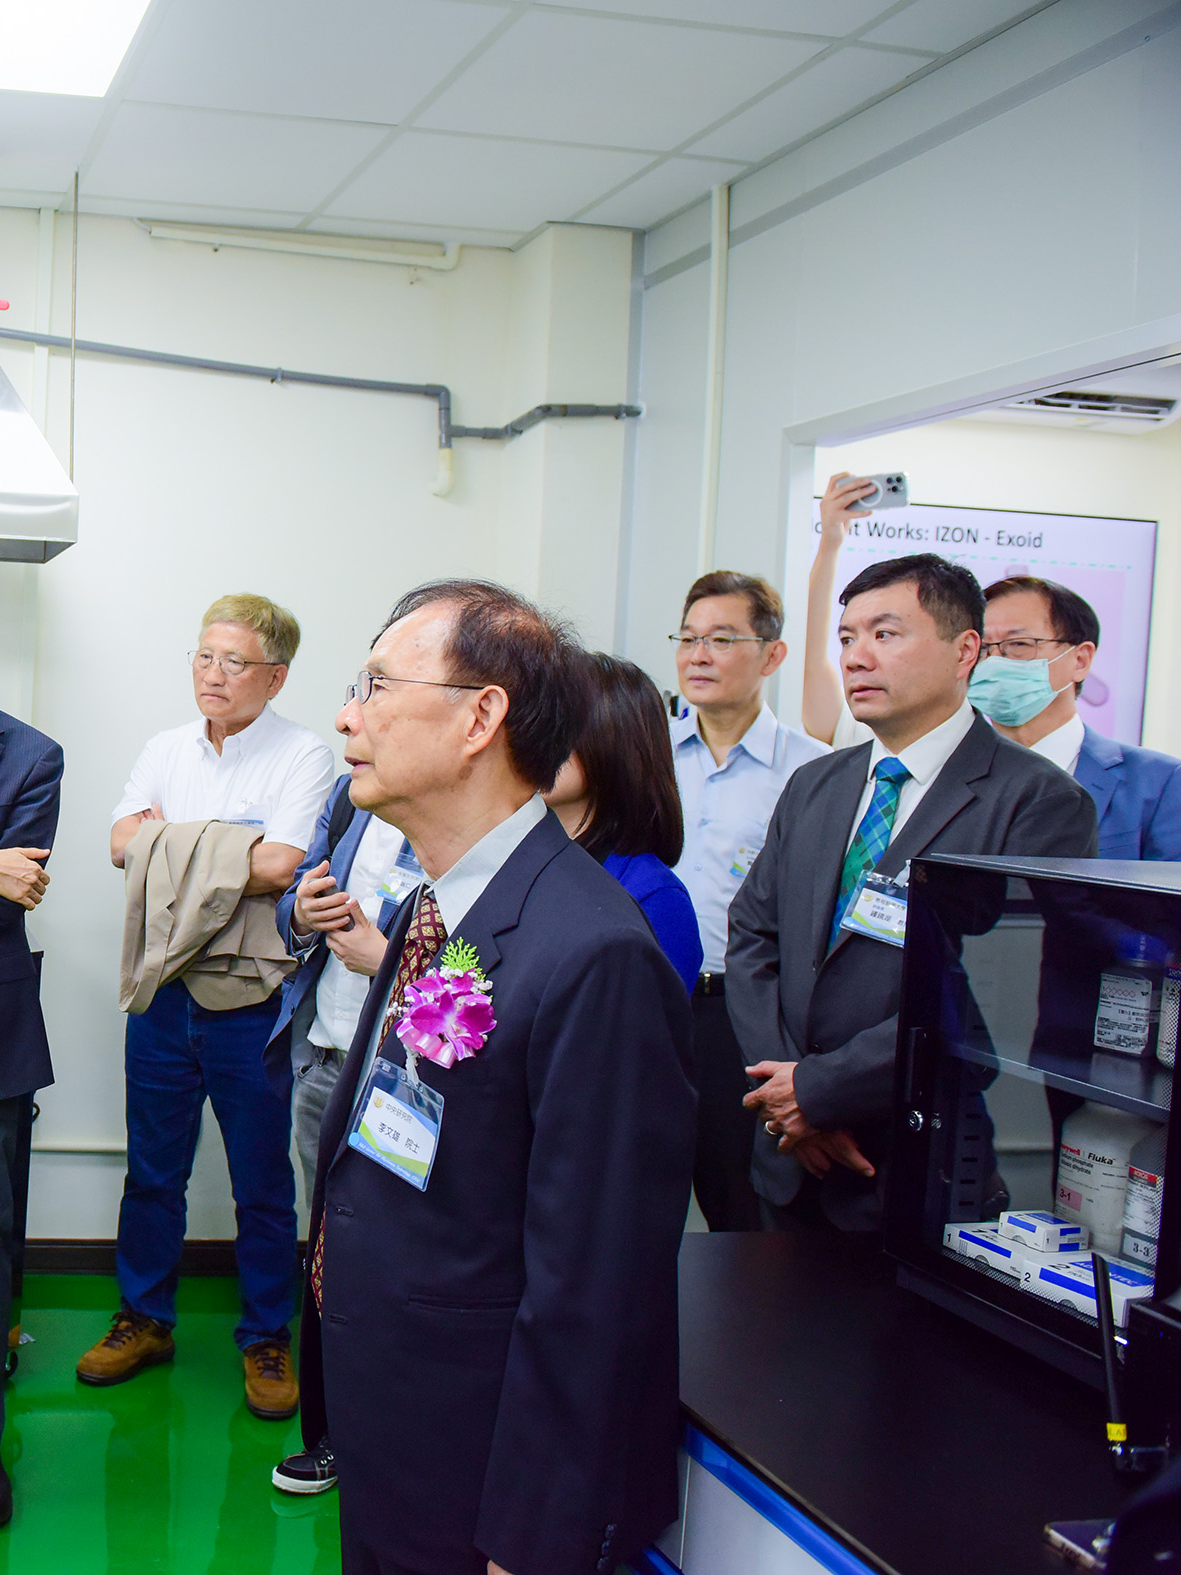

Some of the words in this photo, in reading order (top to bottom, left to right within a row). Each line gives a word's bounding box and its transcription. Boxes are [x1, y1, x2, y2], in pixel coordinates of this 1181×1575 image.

[867, 521, 929, 541] Works:
[935, 525, 979, 544] IZON
[996, 530, 1043, 549] Exoid
[385, 1103, 414, 1125] 中央研究院
[404, 1137, 420, 1155] 院士
[1088, 1152, 1114, 1165] Fluka
[1059, 1188, 1071, 1202] 3-1
[1132, 1242, 1150, 1257] 3-3
[1024, 1272, 1032, 1283] 2
